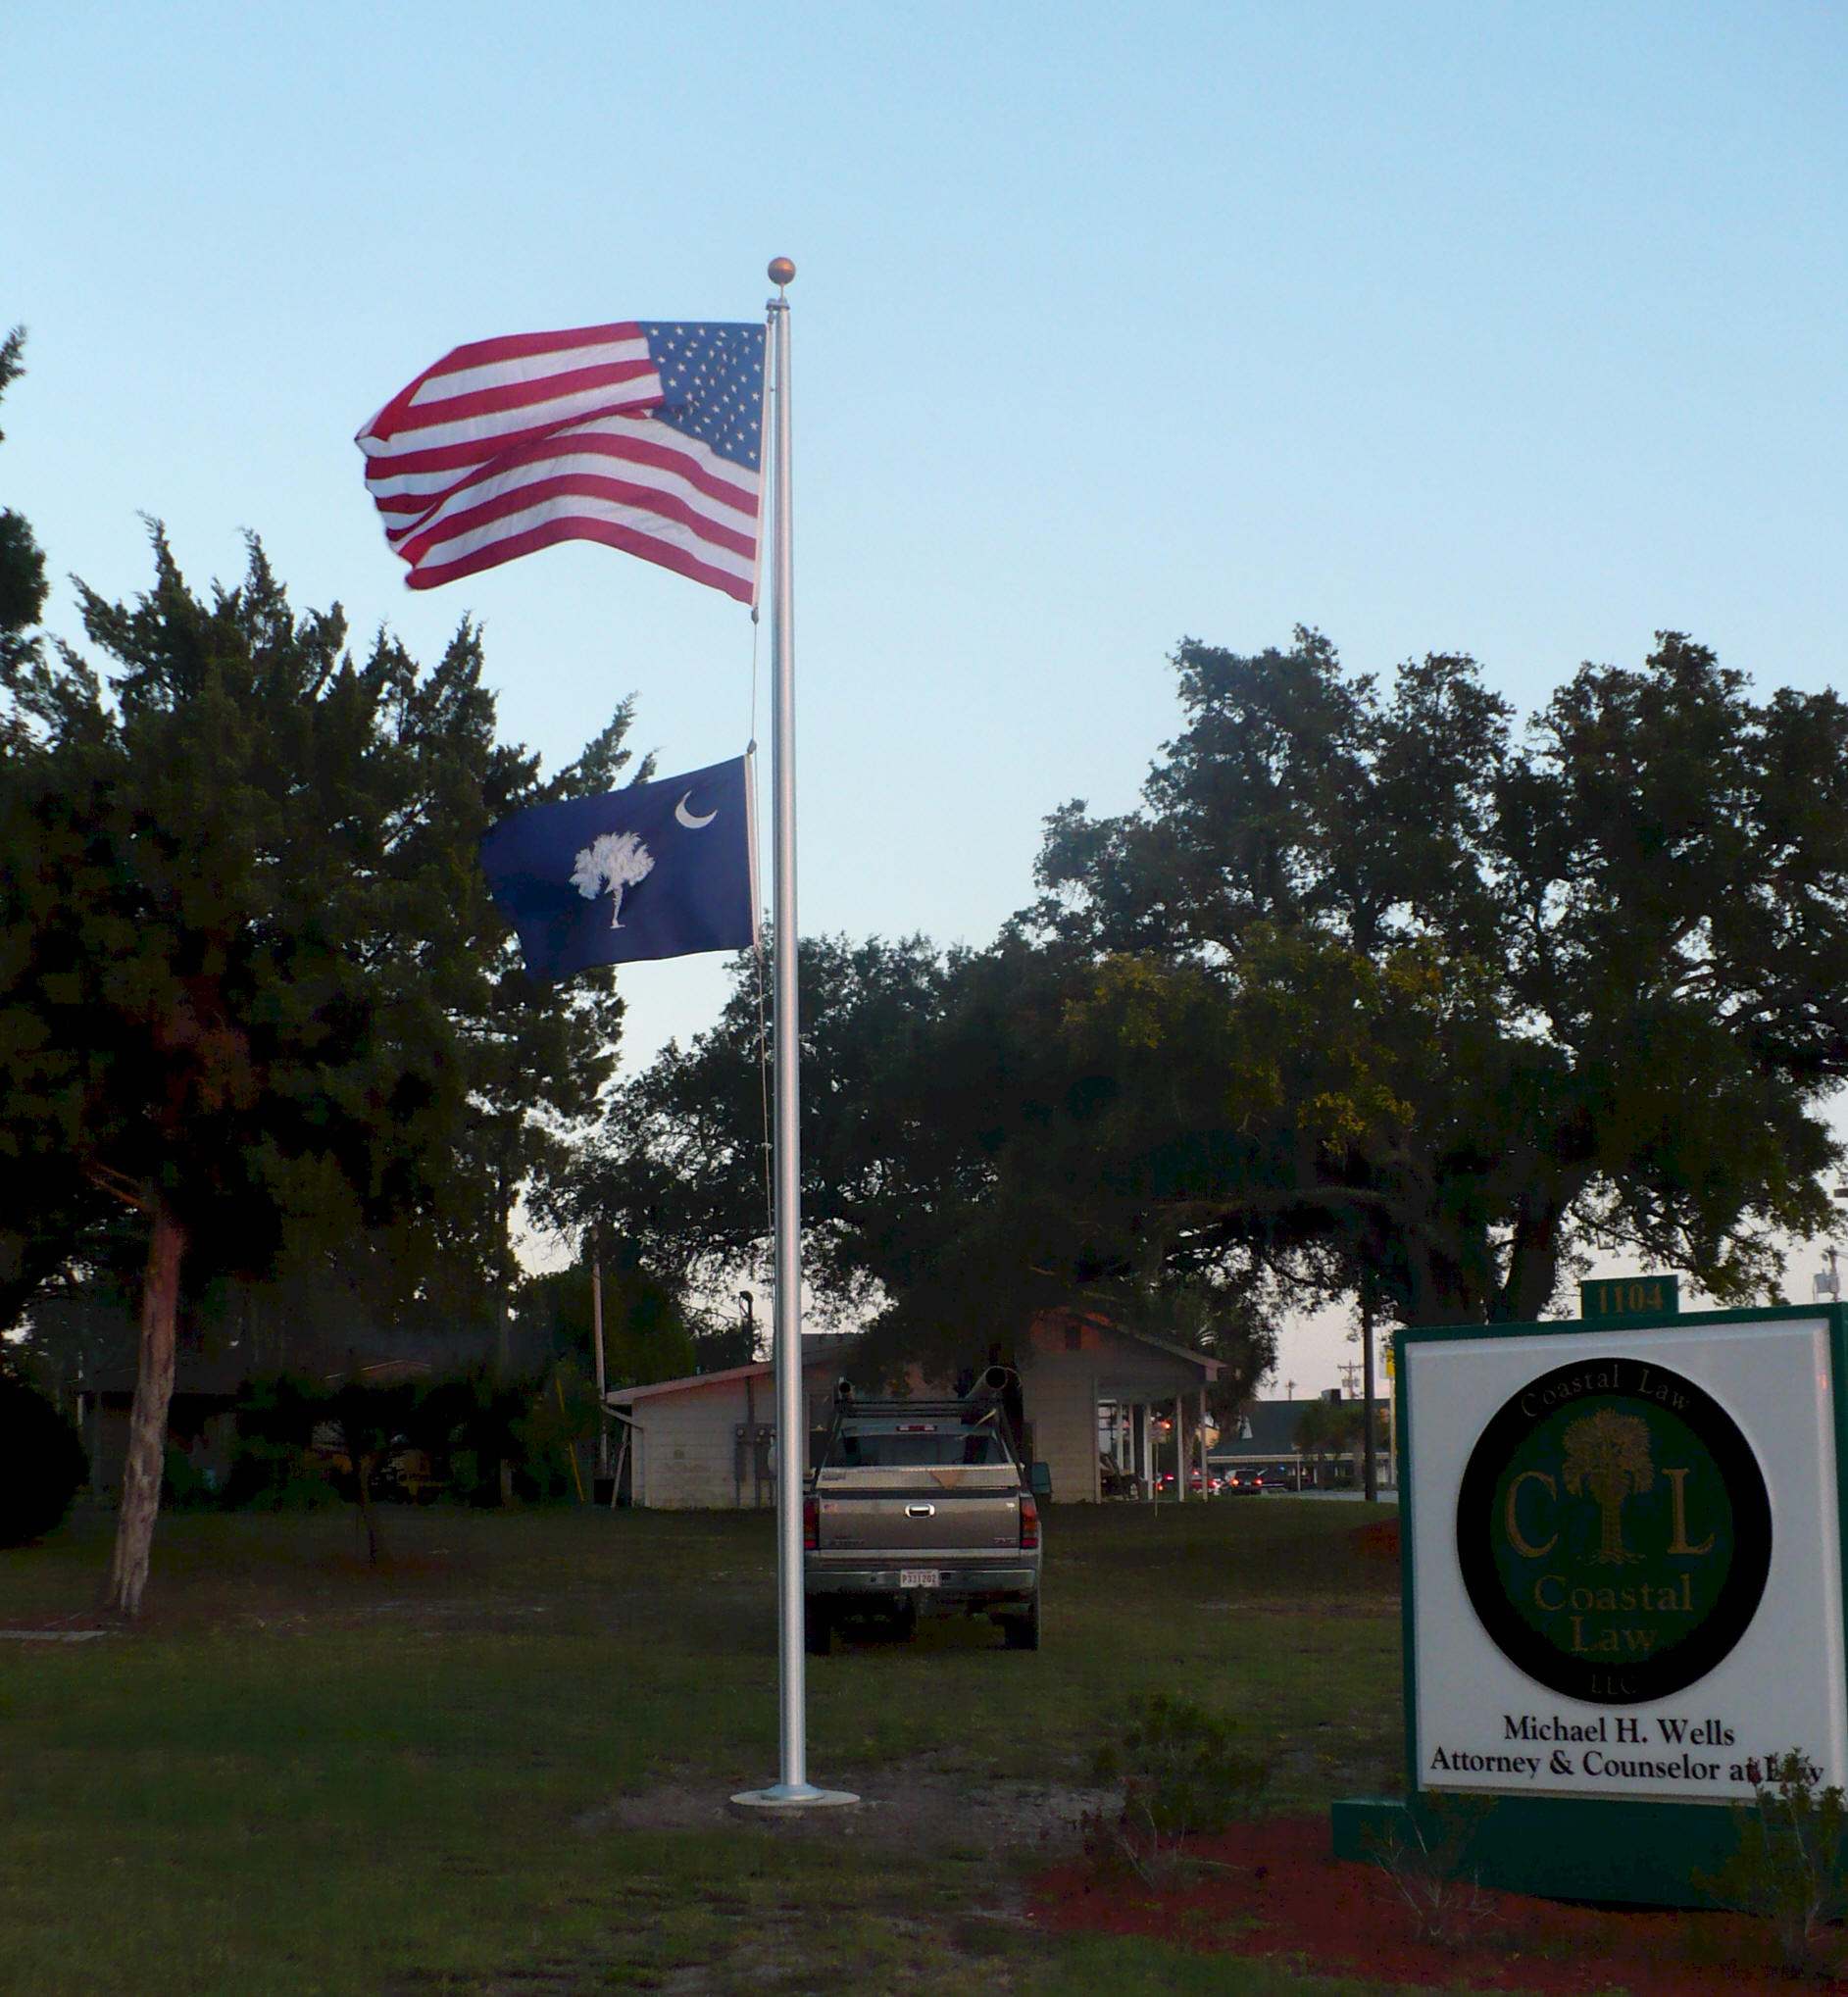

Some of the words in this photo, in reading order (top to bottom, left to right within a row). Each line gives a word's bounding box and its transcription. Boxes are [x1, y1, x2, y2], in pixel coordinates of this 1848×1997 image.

[1597, 1281, 1664, 1314] 1104
[1521, 1364, 1621, 1418] Coastal
[1637, 1369, 1692, 1411] Law
[1504, 1470, 1559, 1559] C
[1661, 1467, 1716, 1556] L
[1533, 1572, 1694, 1612] Coastal
[1569, 1615, 1659, 1653] Law
[1590, 1672, 1638, 1695] LLC
[1504, 1715, 1607, 1742] Michael
[1615, 1719, 1647, 1743] H.
[1658, 1719, 1735, 1746] Wells
[1430, 1747, 1541, 1778] Attorney
[1549, 1750, 1574, 1774] &
[1583, 1751, 1721, 1780] Counselor
